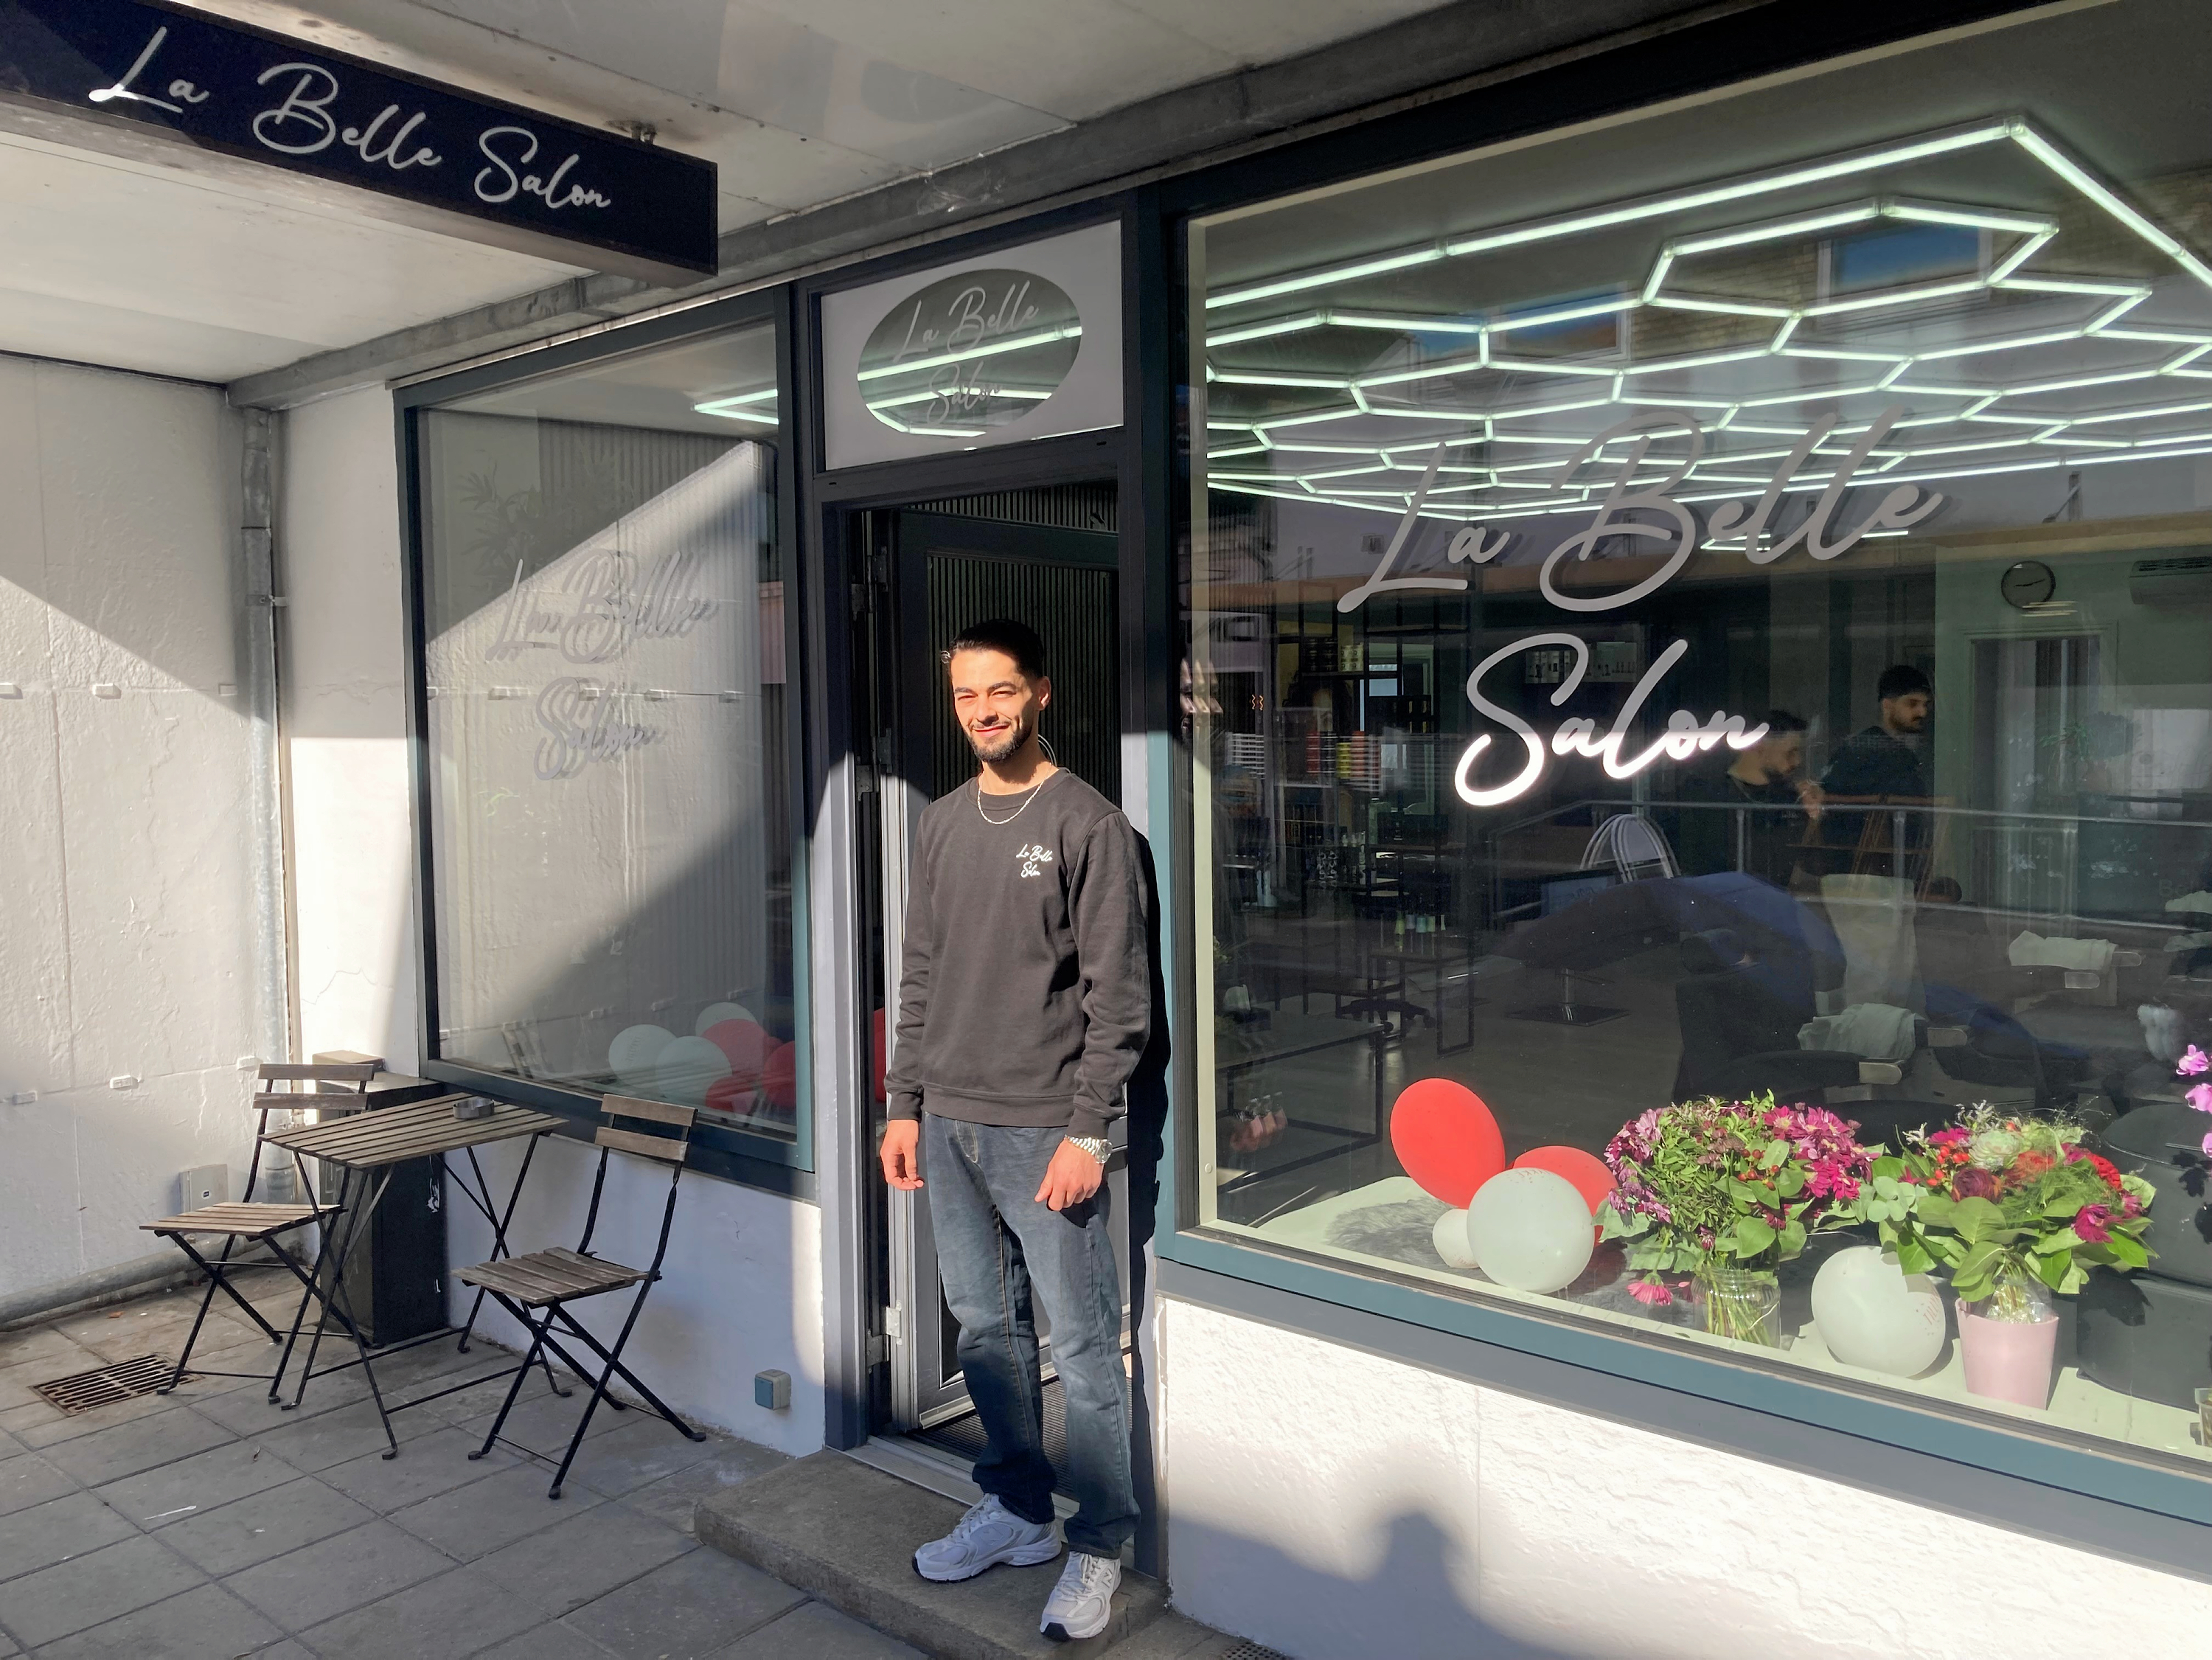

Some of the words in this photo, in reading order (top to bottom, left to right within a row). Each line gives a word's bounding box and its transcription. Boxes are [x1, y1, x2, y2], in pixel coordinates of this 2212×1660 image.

[89, 27, 208, 112] La
[252, 62, 441, 169] Belle
[474, 127, 611, 209] Salon
[893, 299, 939, 364] La
[947, 280, 1039, 355] Belle
[1337, 442, 1510, 613] La
[1540, 404, 1943, 611] Belle
[1455, 633, 1770, 807] Salon
